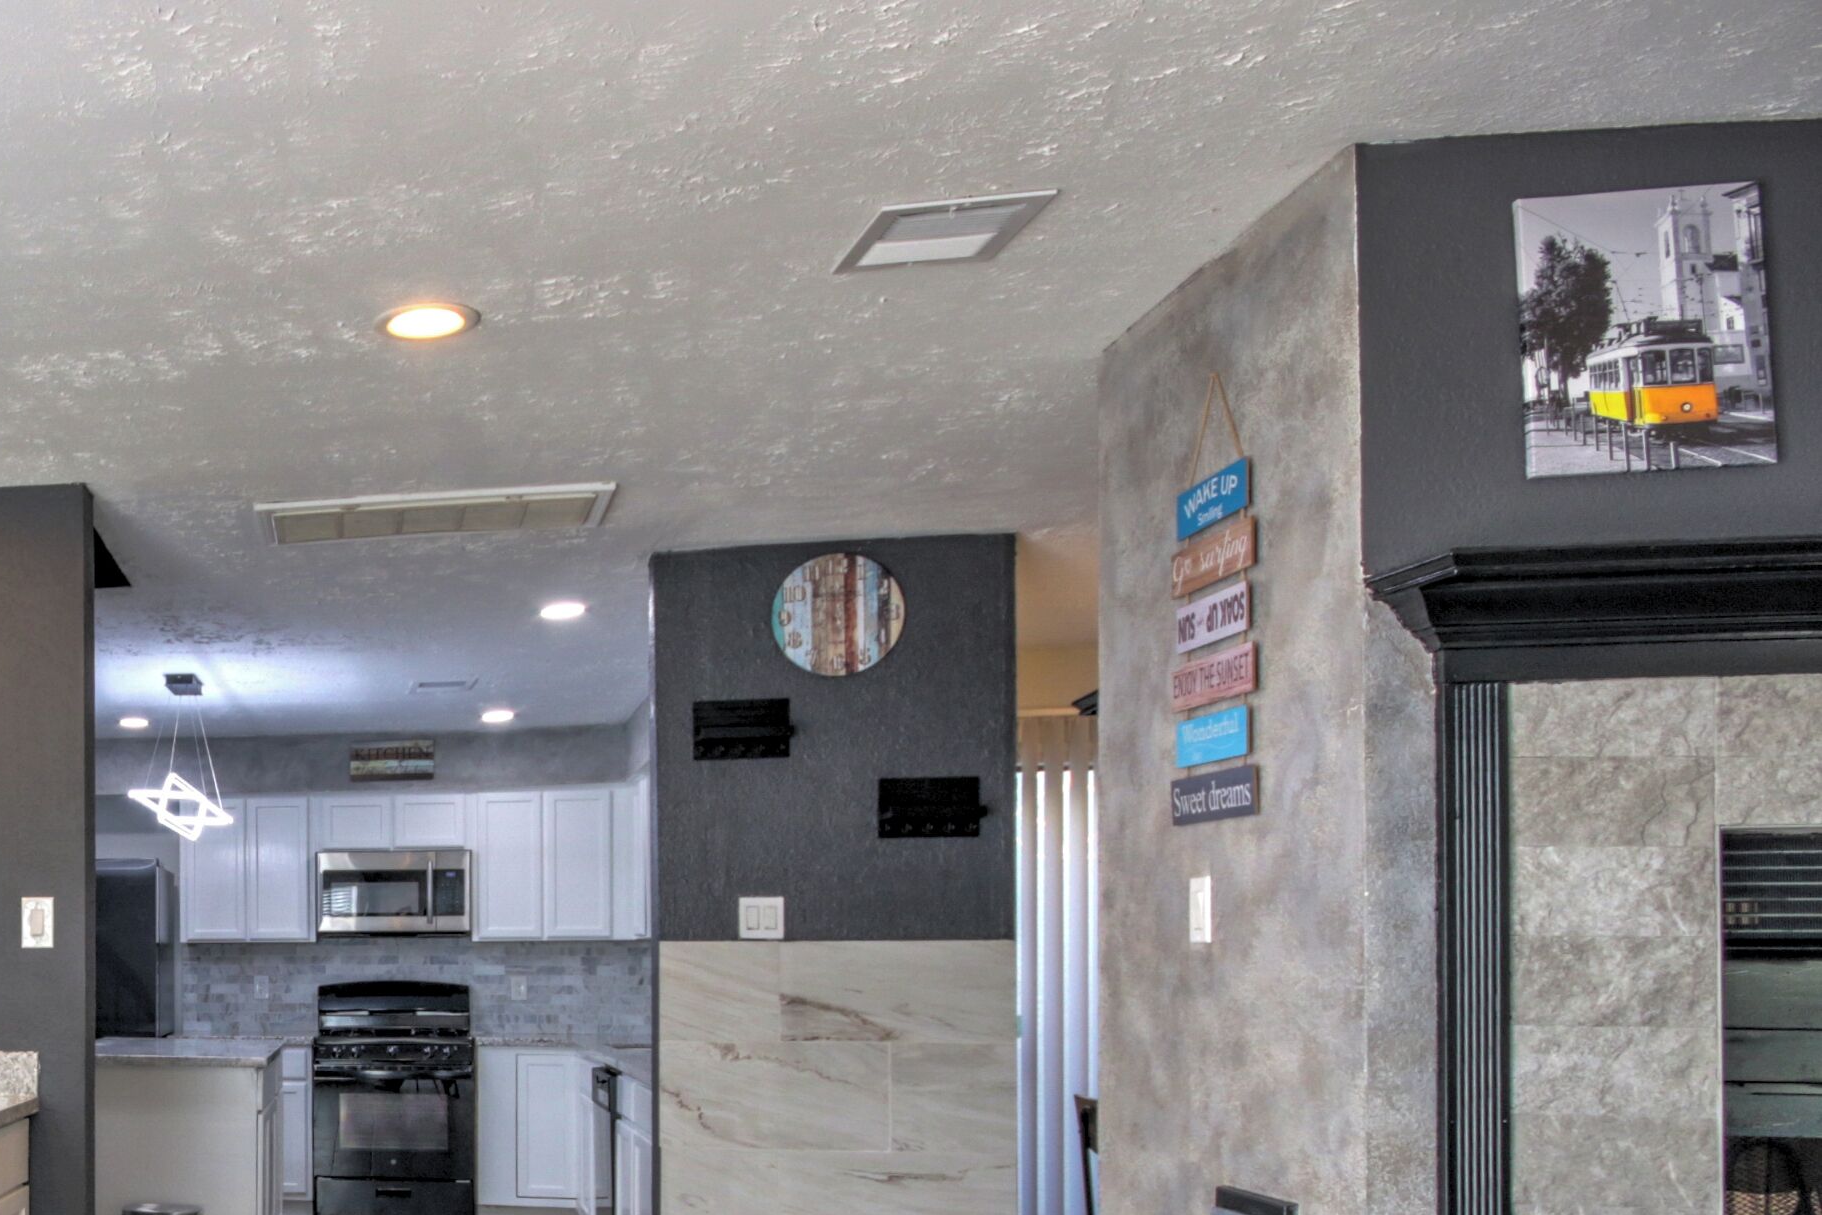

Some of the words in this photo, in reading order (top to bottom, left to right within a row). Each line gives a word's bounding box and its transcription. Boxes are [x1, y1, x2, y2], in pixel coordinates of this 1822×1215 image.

[1184, 477, 1218, 519] WAKE
[1220, 474, 1238, 496] UP
[1172, 556, 1192, 597] Go
[1200, 529, 1248, 577] surfing
[1206, 603, 1219, 633] UP
[1219, 591, 1245, 628] SOAK
[1178, 612, 1196, 645] SUN
[1173, 670, 1197, 699] ENJOY
[1199, 664, 1215, 695] THE
[1216, 652, 1250, 688] SUNSET
[1181, 712, 1239, 745] Wonderful
[354, 745, 434, 760] KITCHEN
[1173, 787, 1206, 817] Sweet
[1208, 780, 1252, 811] dreams
